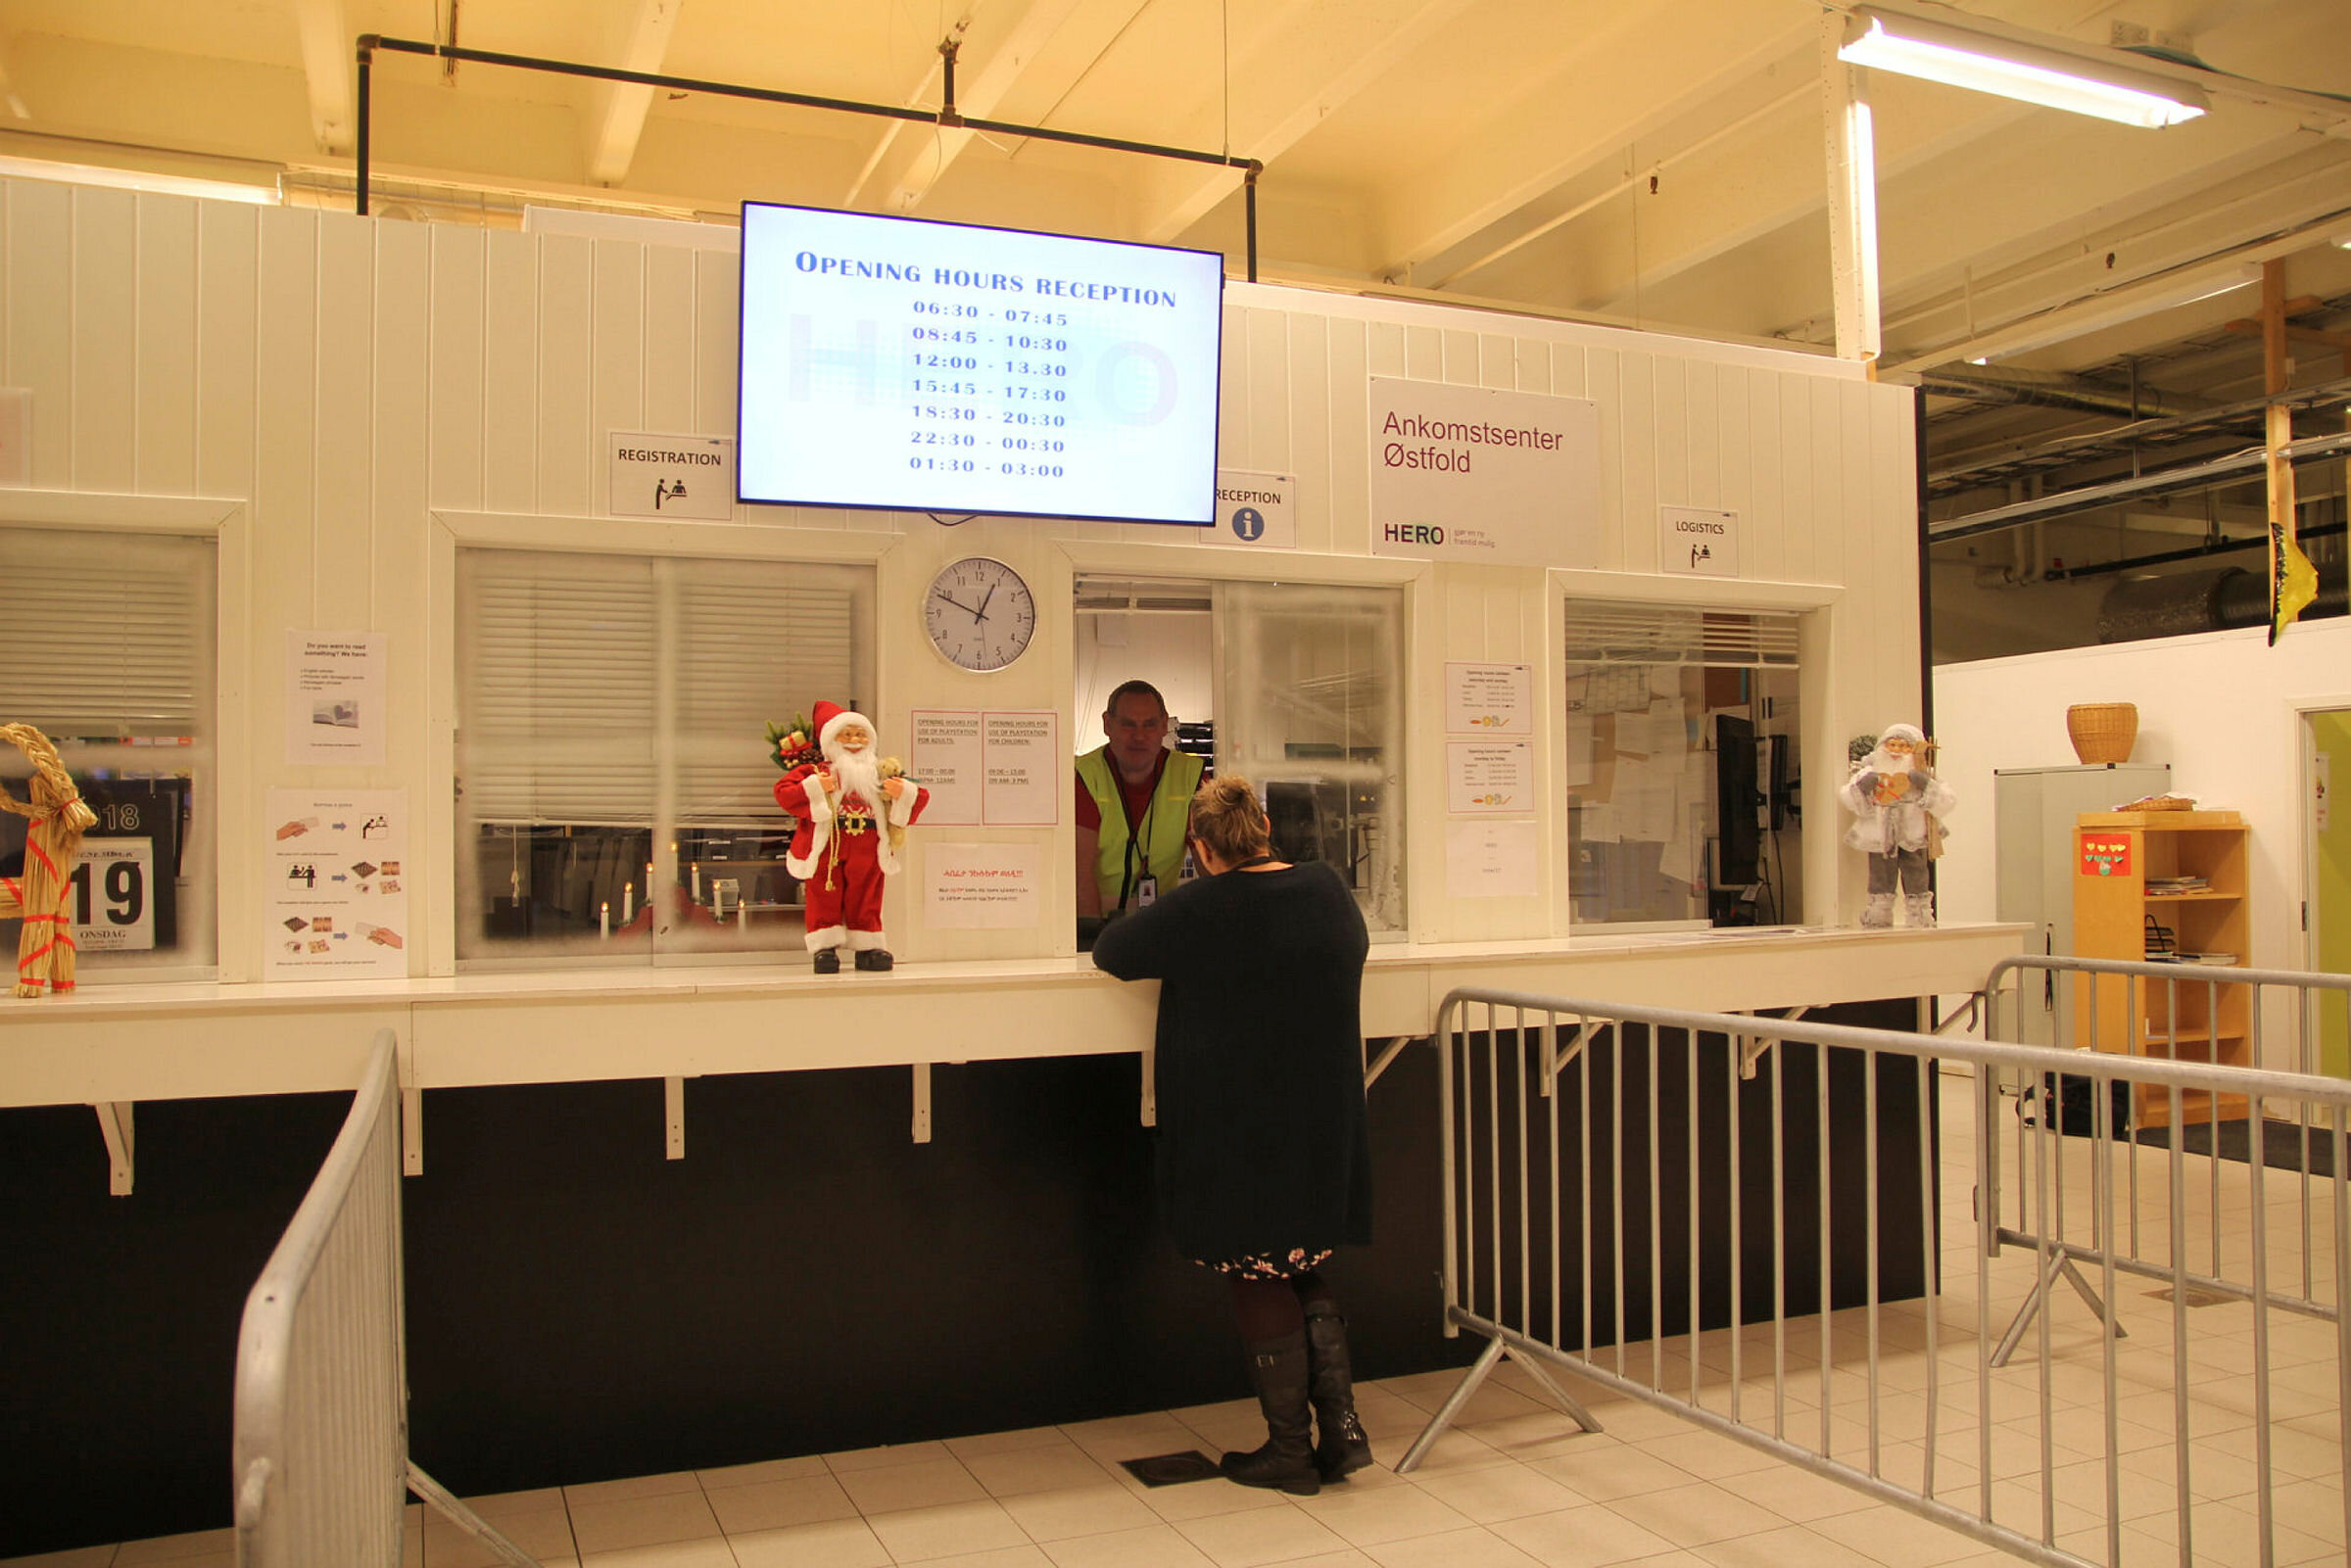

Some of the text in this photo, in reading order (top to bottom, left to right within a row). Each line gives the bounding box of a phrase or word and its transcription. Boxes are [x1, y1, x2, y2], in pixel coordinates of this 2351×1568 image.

[934, 268, 1024, 293] HOURS
[1035, 278, 1176, 308] RECEPTION
[913, 300, 979, 319] 06:30
[1005, 309, 1068, 327] 07:45
[912, 326, 978, 346] 08:45
[1005, 335, 1068, 354] 10:30
[912, 353, 978, 371] 12:00
[1005, 360, 1067, 378] 13.30
[912, 379, 977, 397] 15:45
[1003, 386, 1067, 404] 17:30
[911, 404, 976, 422] 18:30
[1002, 411, 1066, 428] 20:30
[910, 430, 976, 448] 22:30
[1001, 438, 1065, 454] 00:30
[1383, 410, 1563, 451] Ankomstsenter
[618, 449, 721, 466] REGISTRATION
[909, 456, 975, 473] 01:30
[1001, 463, 1065, 479] 03:00
[1384, 443, 1470, 473] Østfold
[1216, 489, 1281, 504] RECEPTION
[1384, 523, 1445, 546] HERO
[1676, 521, 1725, 535] LOGISTICS
[957, 576, 966, 587] 11
[975, 571, 984, 581] 12
[997, 578, 1001, 588] 1
[1011, 593, 1016, 602] 2
[70, 861, 144, 926] 19
